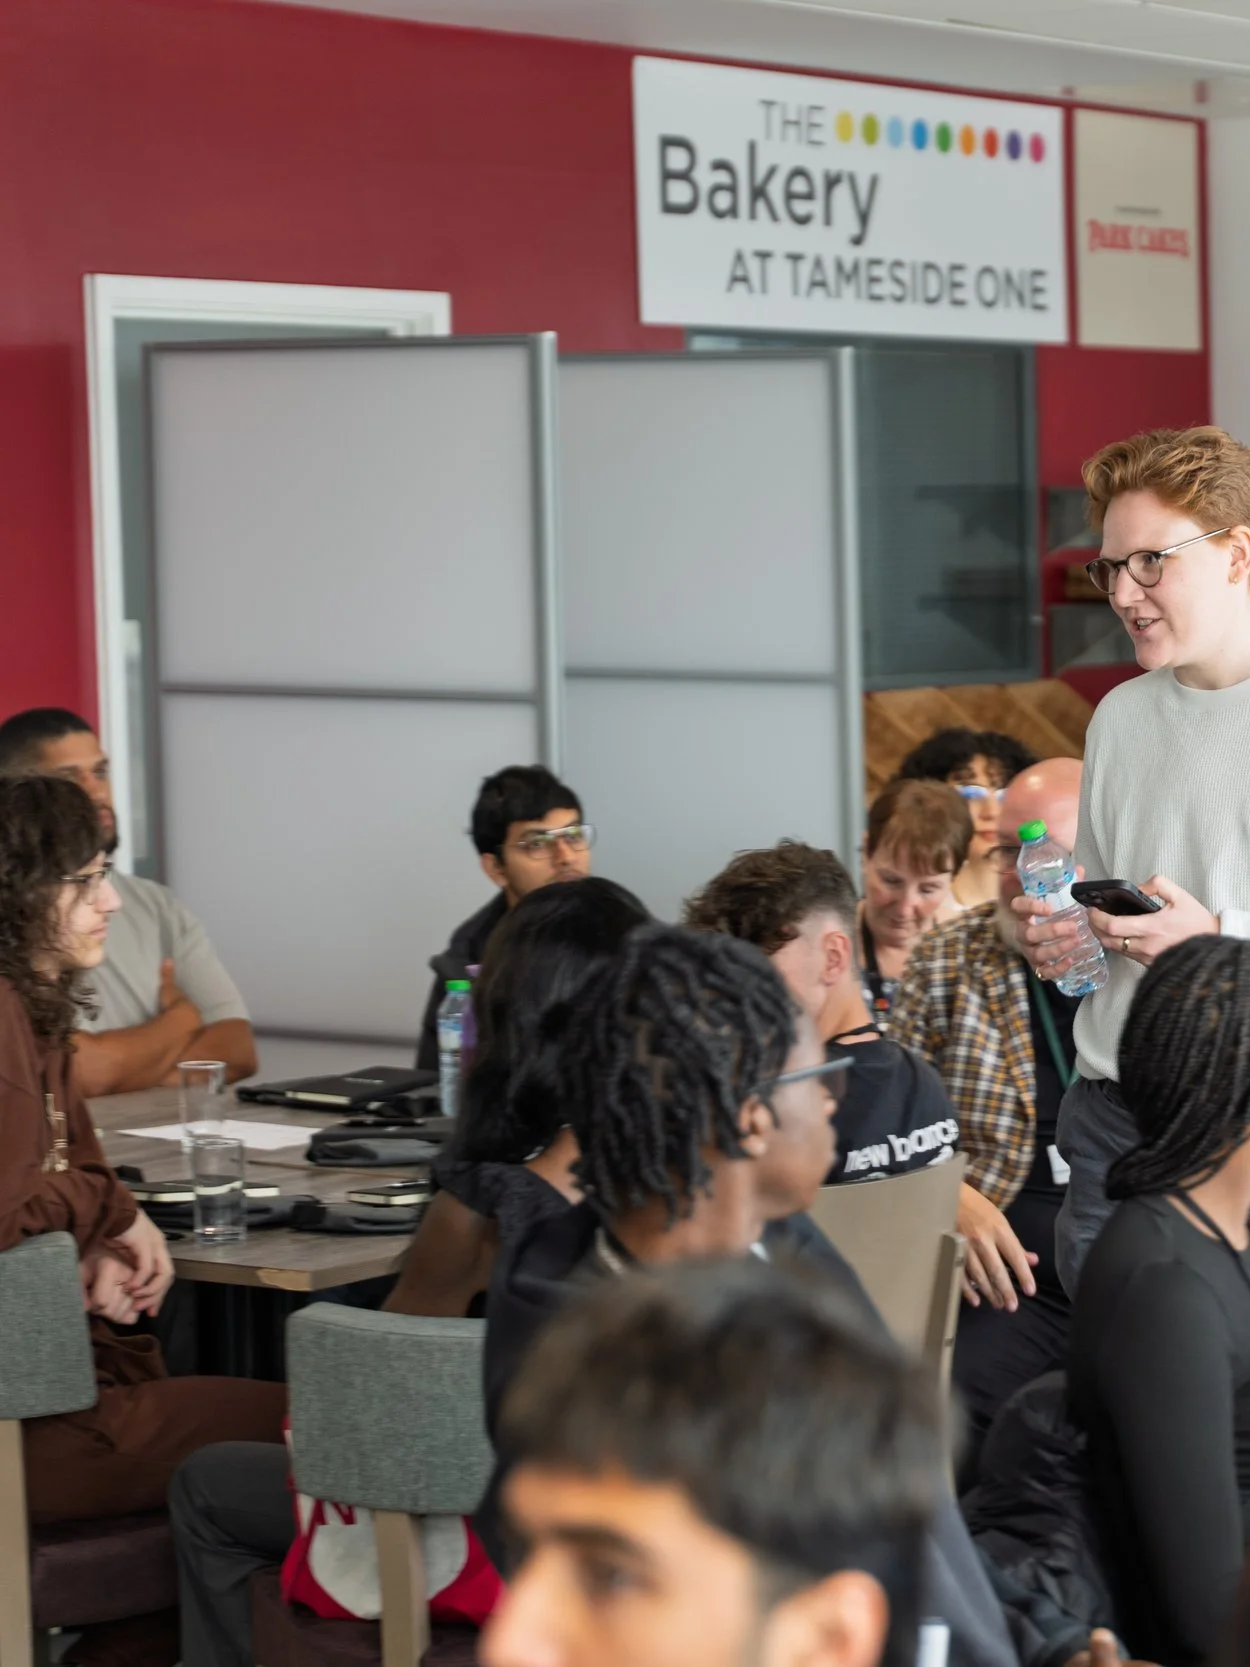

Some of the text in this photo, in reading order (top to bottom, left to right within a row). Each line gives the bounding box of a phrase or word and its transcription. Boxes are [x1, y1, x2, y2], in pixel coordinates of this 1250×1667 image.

[759, 98, 826, 146] THE
[658, 133, 880, 247] Bakery
[726, 248, 1048, 312] AT TAMESIDE ONE
